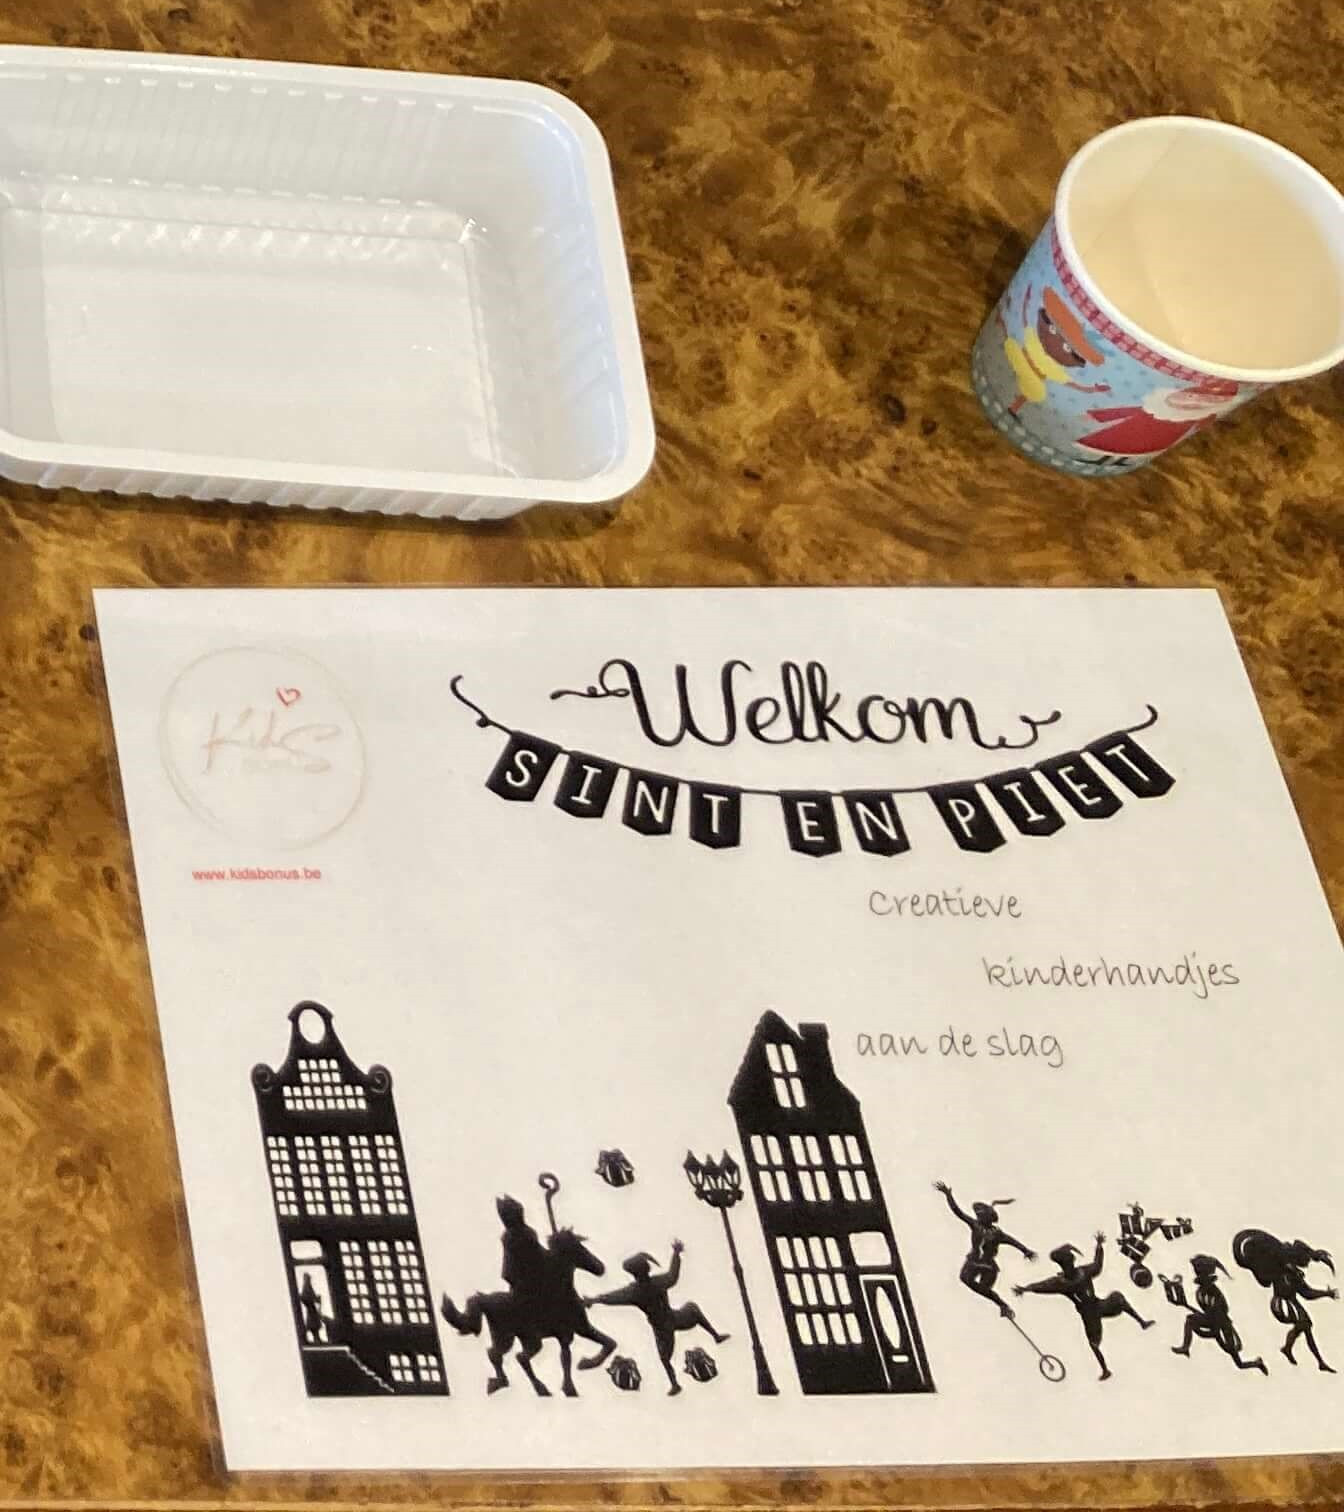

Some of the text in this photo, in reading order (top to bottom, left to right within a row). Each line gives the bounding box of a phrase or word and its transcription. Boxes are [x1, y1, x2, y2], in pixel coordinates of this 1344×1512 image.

[549, 657, 1062, 750] Welkom
[502, 742, 1153, 844] SINT EN PIET
[191, 867, 322, 881] www.kidsbonus.be
[868, 888, 1023, 919] Creatieve
[981, 951, 1241, 1000] kinderhandjes
[856, 1024, 1065, 1069] aan de slag
